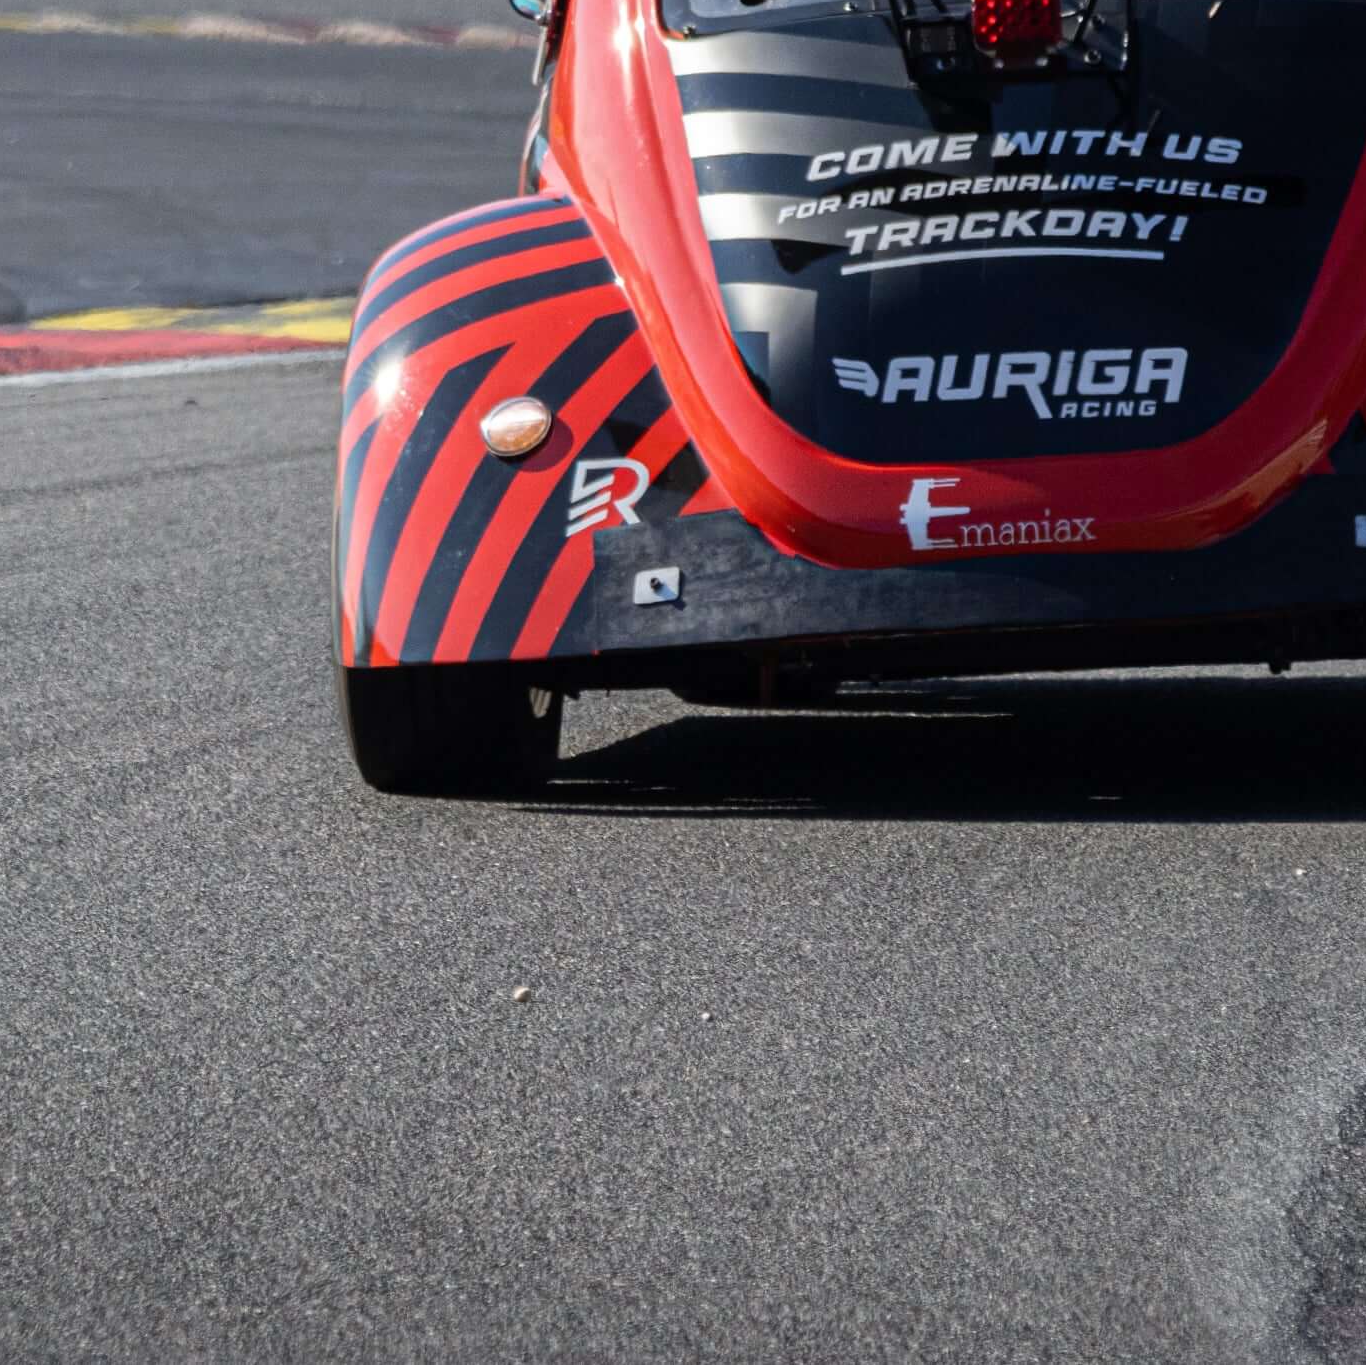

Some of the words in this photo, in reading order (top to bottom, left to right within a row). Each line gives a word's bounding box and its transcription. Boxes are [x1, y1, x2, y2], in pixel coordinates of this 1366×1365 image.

[806, 133, 979, 183] COME
[991, 129, 1149, 159] WITH
[1161, 133, 1244, 165] US
[777, 194, 843, 226] FOR
[847, 187, 896, 211] AN
[899, 173, 1269, 205] ADRENALINE-FUELED
[844, 207, 1189, 257] TRACKDAY!
[880, 346, 1189, 420] AURIGA
